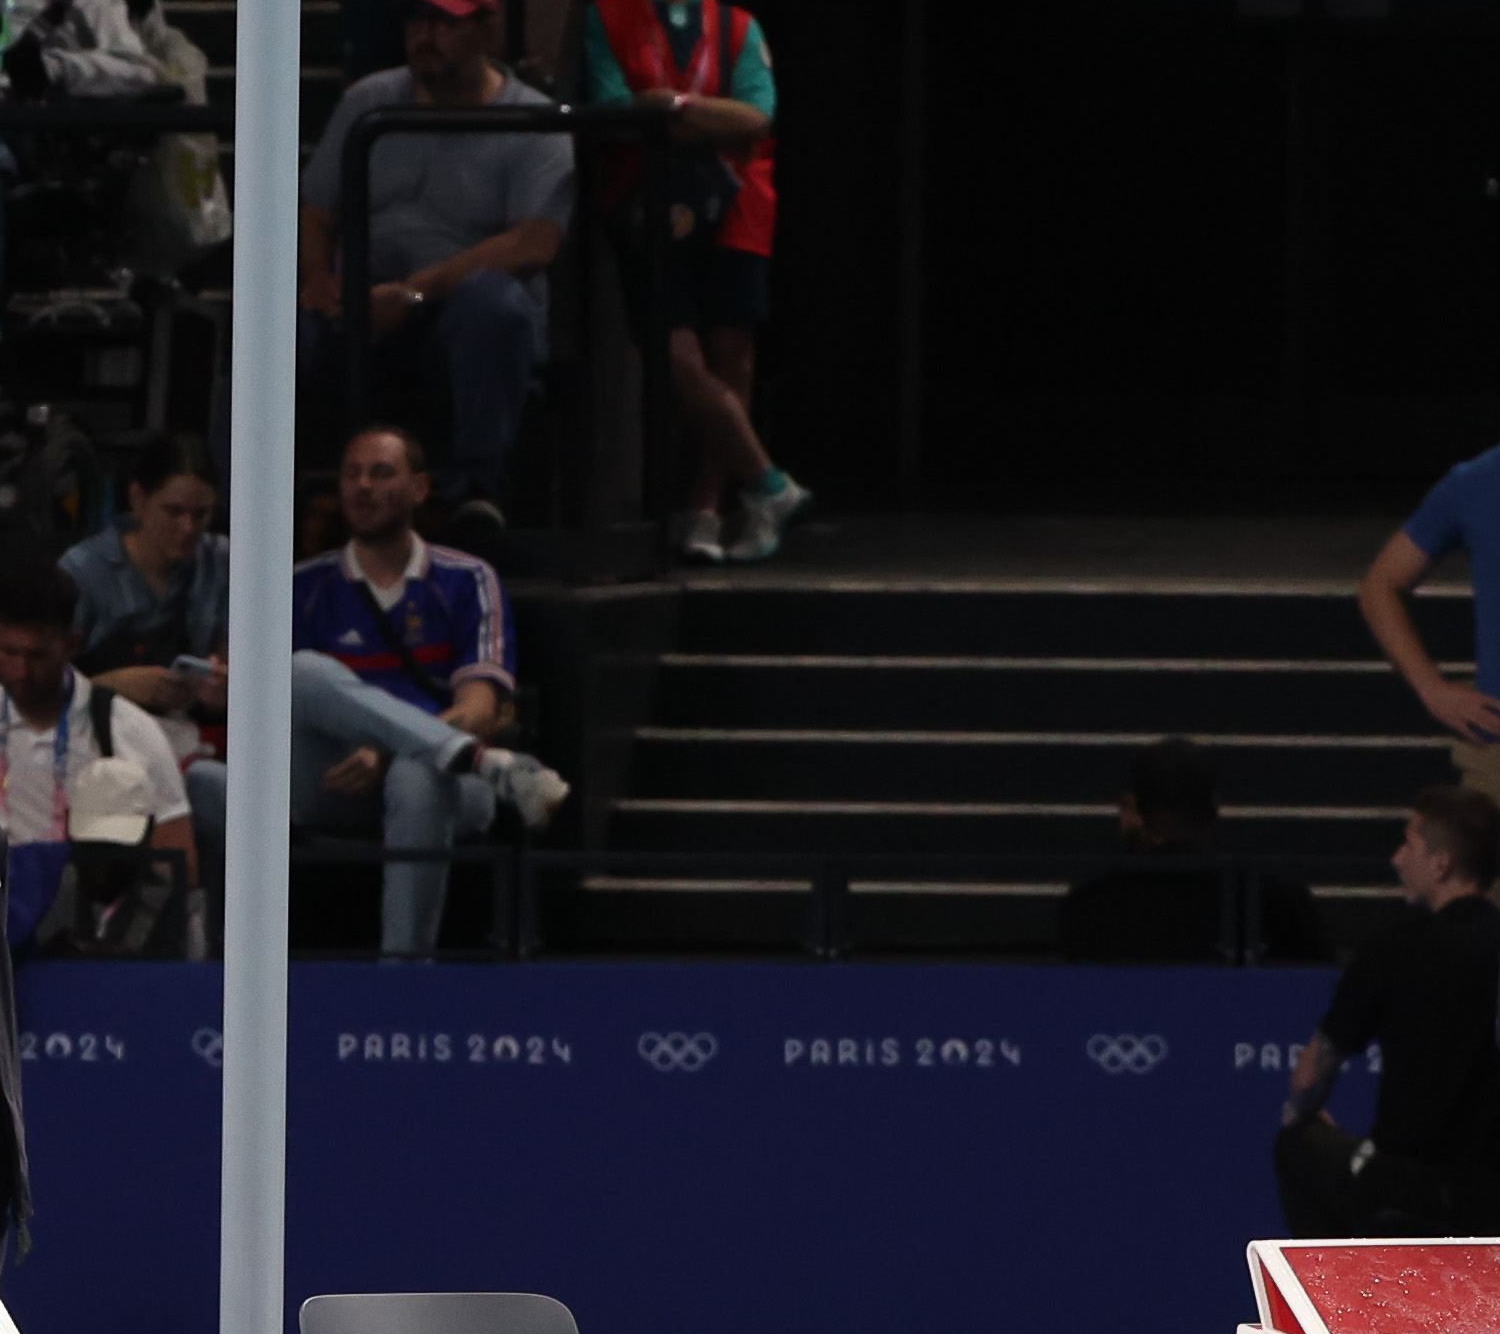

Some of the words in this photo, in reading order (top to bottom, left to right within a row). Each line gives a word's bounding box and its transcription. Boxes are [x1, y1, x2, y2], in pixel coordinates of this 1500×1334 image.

[20, 1030, 125, 1062] 2024
[337, 1032, 452, 1062] PARIS
[466, 1035, 571, 1065] 2024
[784, 1038, 899, 1066] PARIS
[914, 1039, 1021, 1068] 2024
